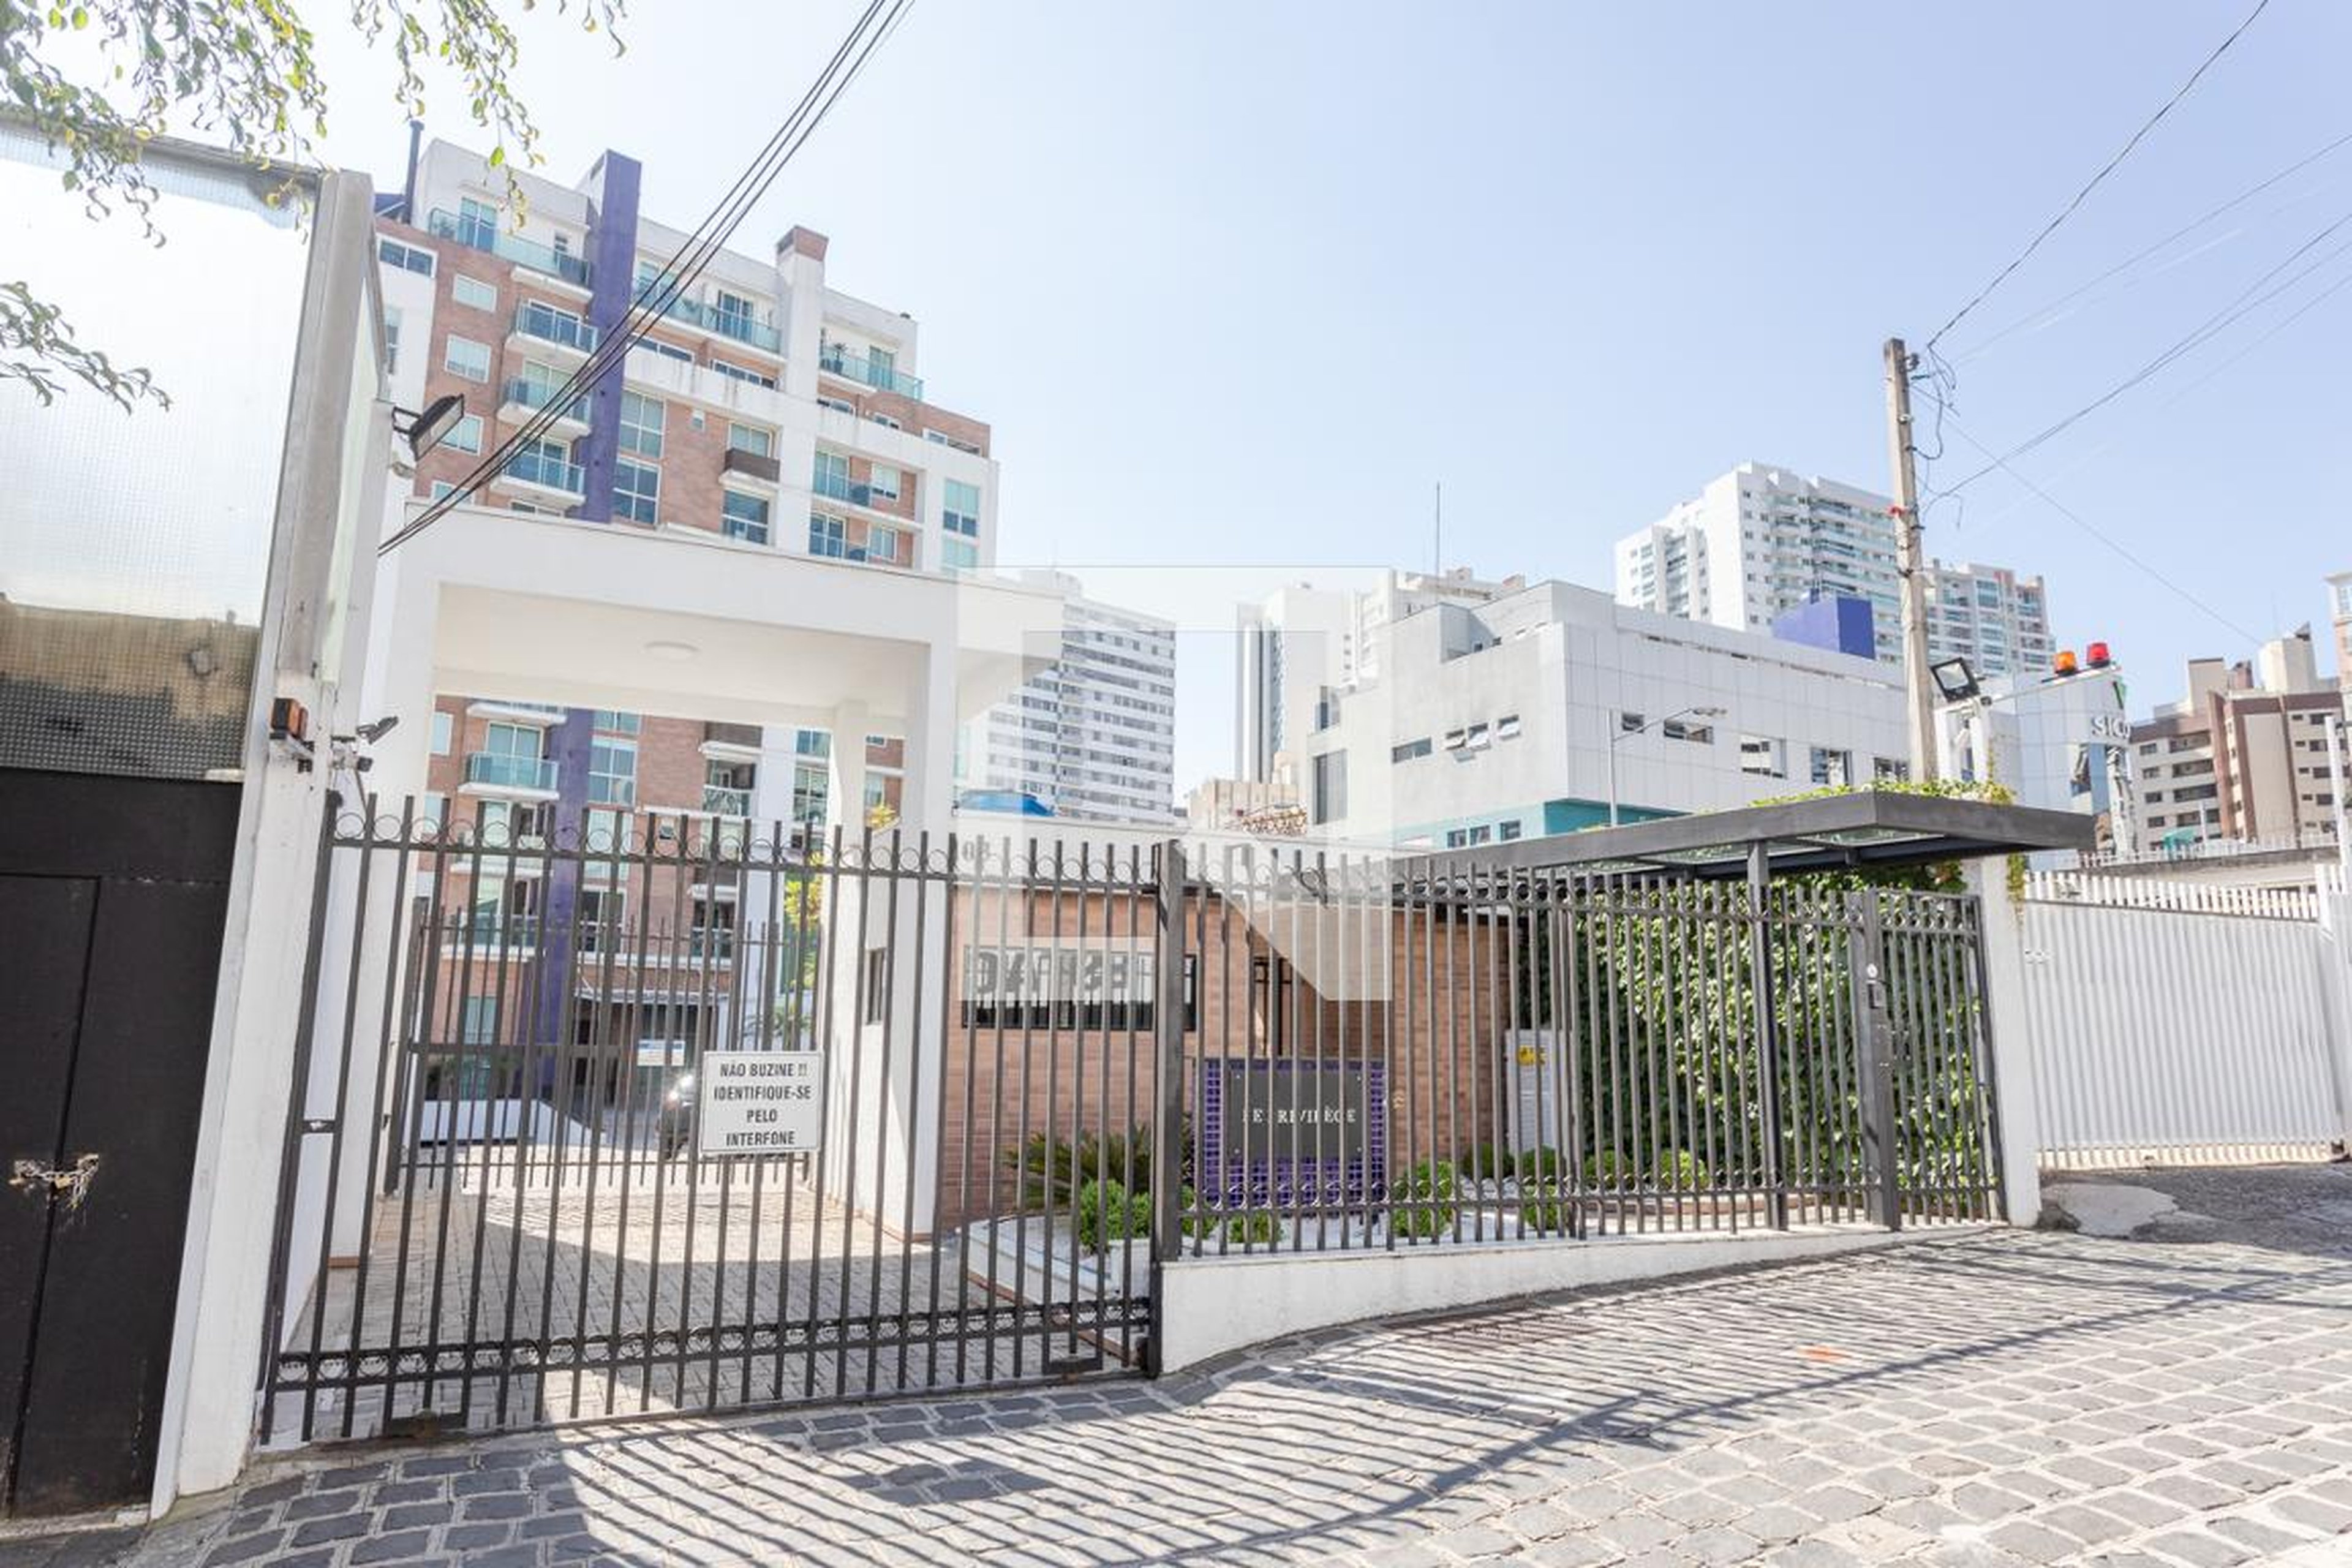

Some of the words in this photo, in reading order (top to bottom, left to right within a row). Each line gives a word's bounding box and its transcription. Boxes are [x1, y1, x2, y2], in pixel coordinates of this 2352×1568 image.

[749, 1063, 794, 1077] BUZINE
[714, 1085, 812, 1101] IDENTIFIQUE-SE
[747, 1109, 778, 1123] PELO
[726, 1131, 795, 1146] INTERFONE
